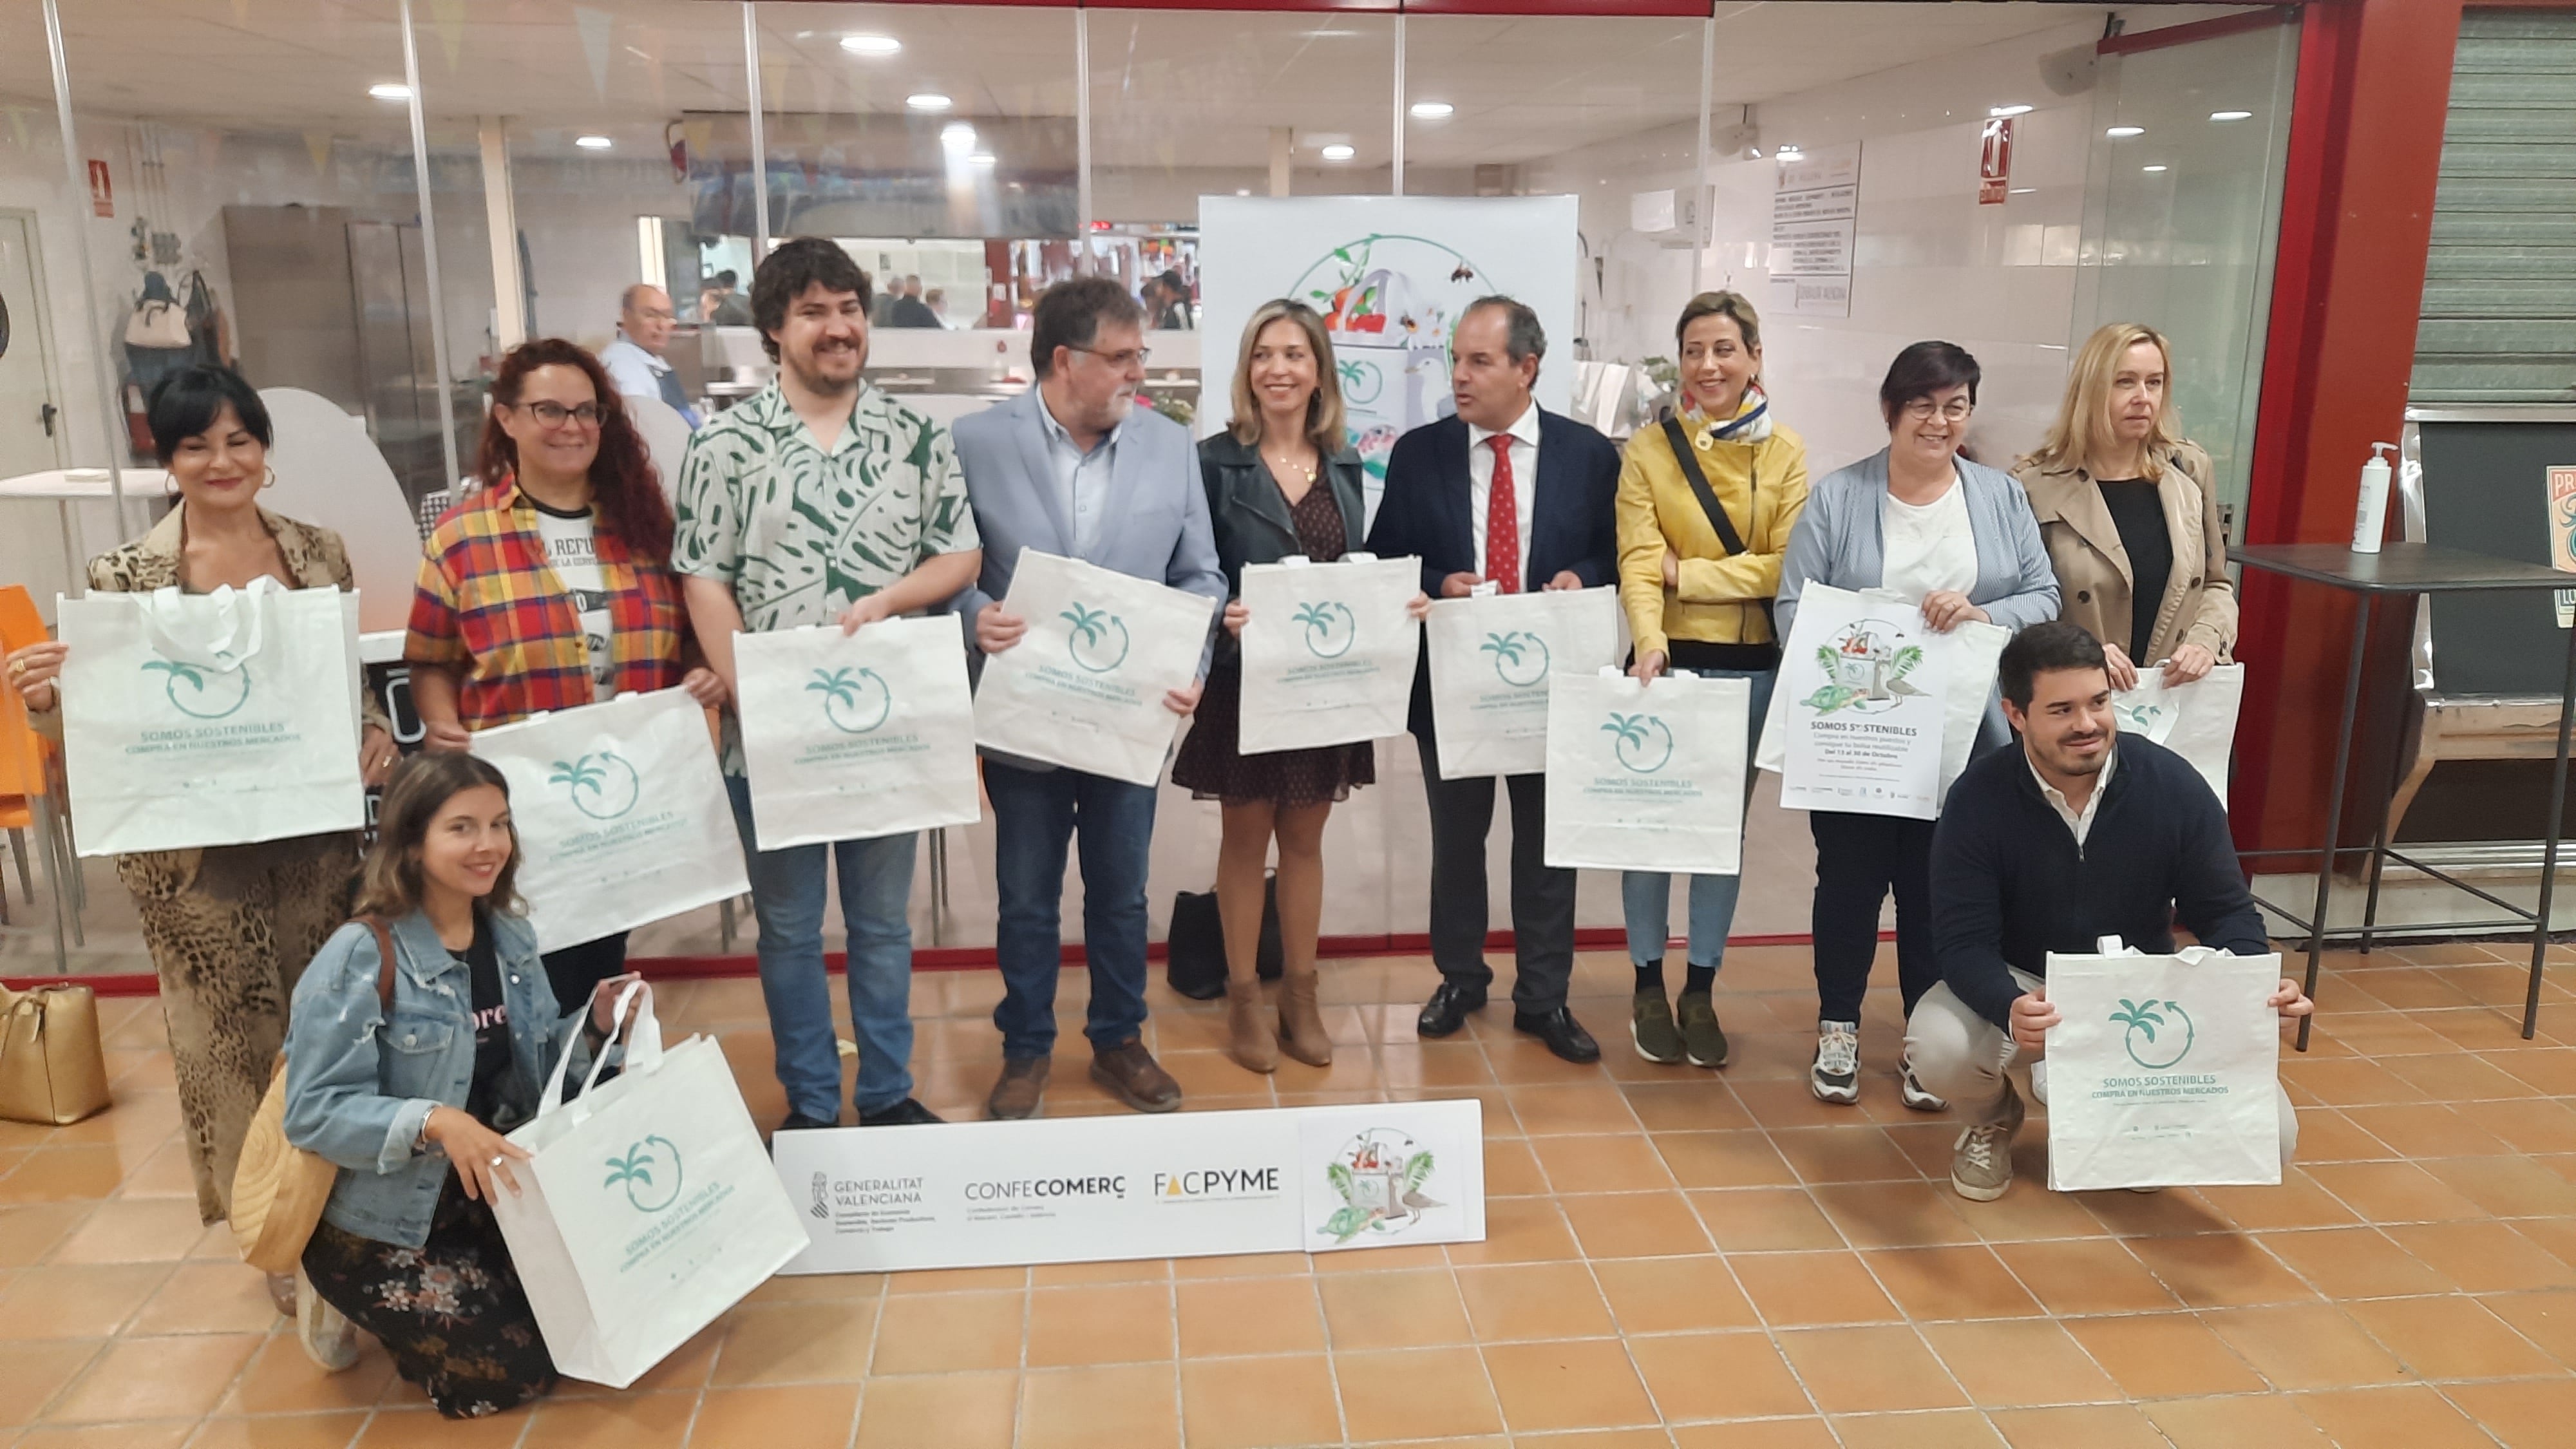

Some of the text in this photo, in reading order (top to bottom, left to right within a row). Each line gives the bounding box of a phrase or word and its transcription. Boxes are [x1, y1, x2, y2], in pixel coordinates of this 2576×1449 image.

[140, 722, 285, 742] SOMOS SOSTENIBLES
[1810, 721, 1847, 731] SOMOS
[2103, 1074, 2216, 1088] SOMOS SOSTENIBLES
[2092, 1086, 2229, 1099] COMPRA EN NUESTROS MERCADOS
[834, 1177, 923, 1192] GENERALITAT
[965, 1175, 1126, 1200] CONFECOMERÇ
[835, 1192, 922, 1206] VALENCIANA
